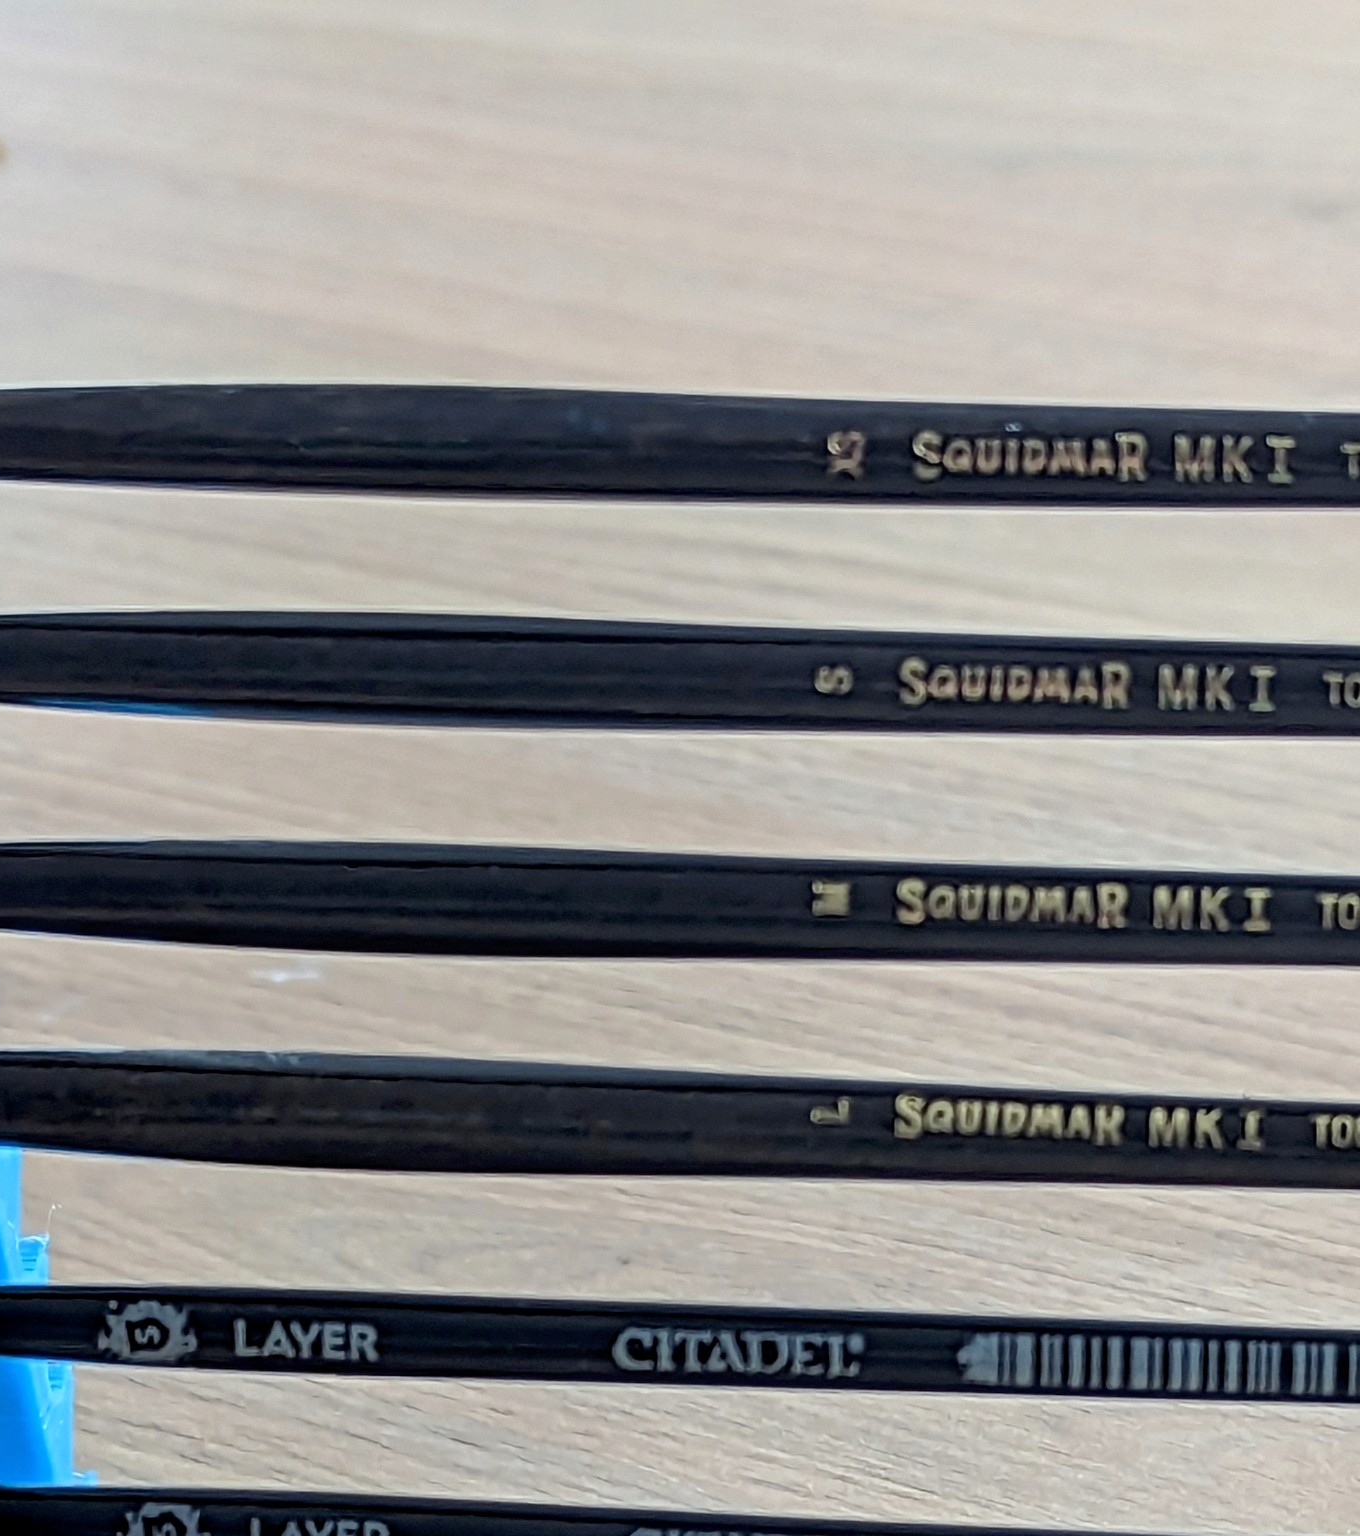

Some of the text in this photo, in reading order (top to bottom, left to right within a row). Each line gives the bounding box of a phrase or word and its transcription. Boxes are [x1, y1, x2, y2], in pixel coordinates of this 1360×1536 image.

[912, 429, 1150, 483] SQUIDMAR
[898, 656, 1132, 711] SQUIDMAR
[896, 877, 1130, 929] SQUIDMAR
[234, 1318, 862, 1378] LAYER CITADEL
